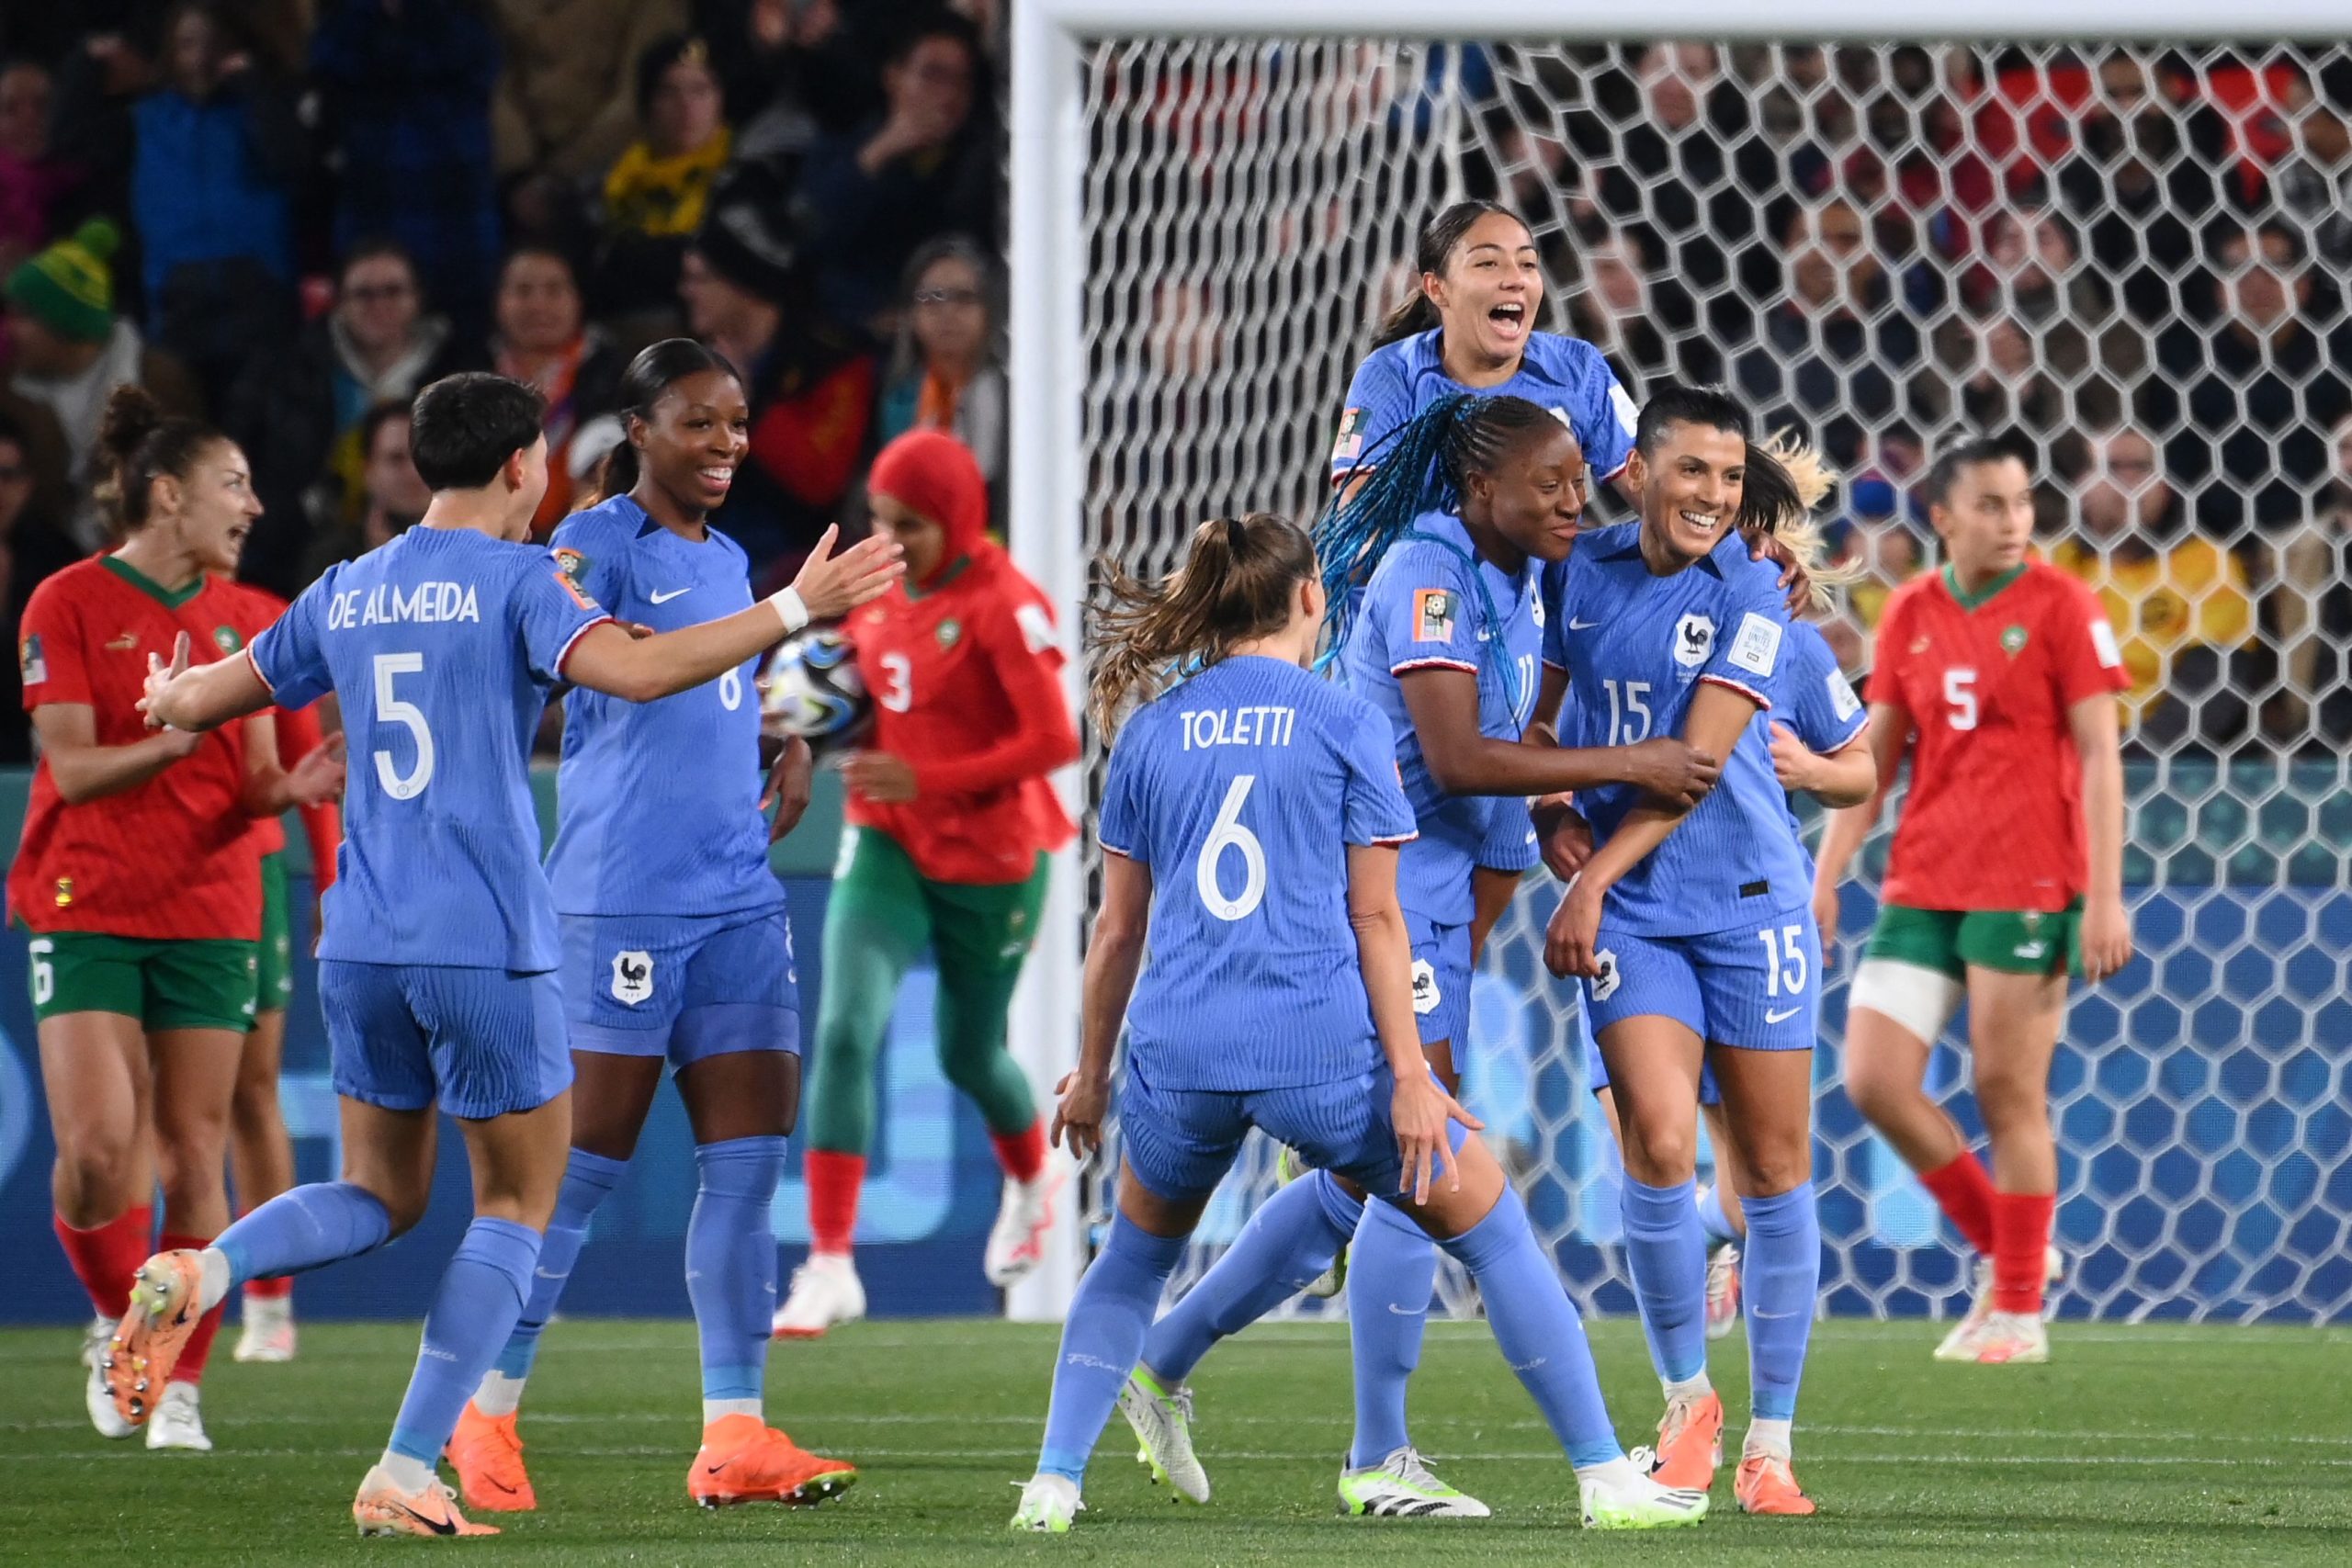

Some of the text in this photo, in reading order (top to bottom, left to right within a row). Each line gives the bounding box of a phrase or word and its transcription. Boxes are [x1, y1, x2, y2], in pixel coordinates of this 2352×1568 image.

[328, 581, 480, 631] DE ALMEIDA
[879, 651, 912, 713] 3
[1510, 653, 1534, 725] 11
[1602, 679, 1652, 747] 15
[1944, 669, 1977, 730] 5
[373, 652, 435, 800] 5
[1180, 706, 1295, 751] TOLETTI
[1196, 774, 1266, 921] 6
[29, 939, 53, 1006] 6
[1758, 925, 1806, 997] 15
